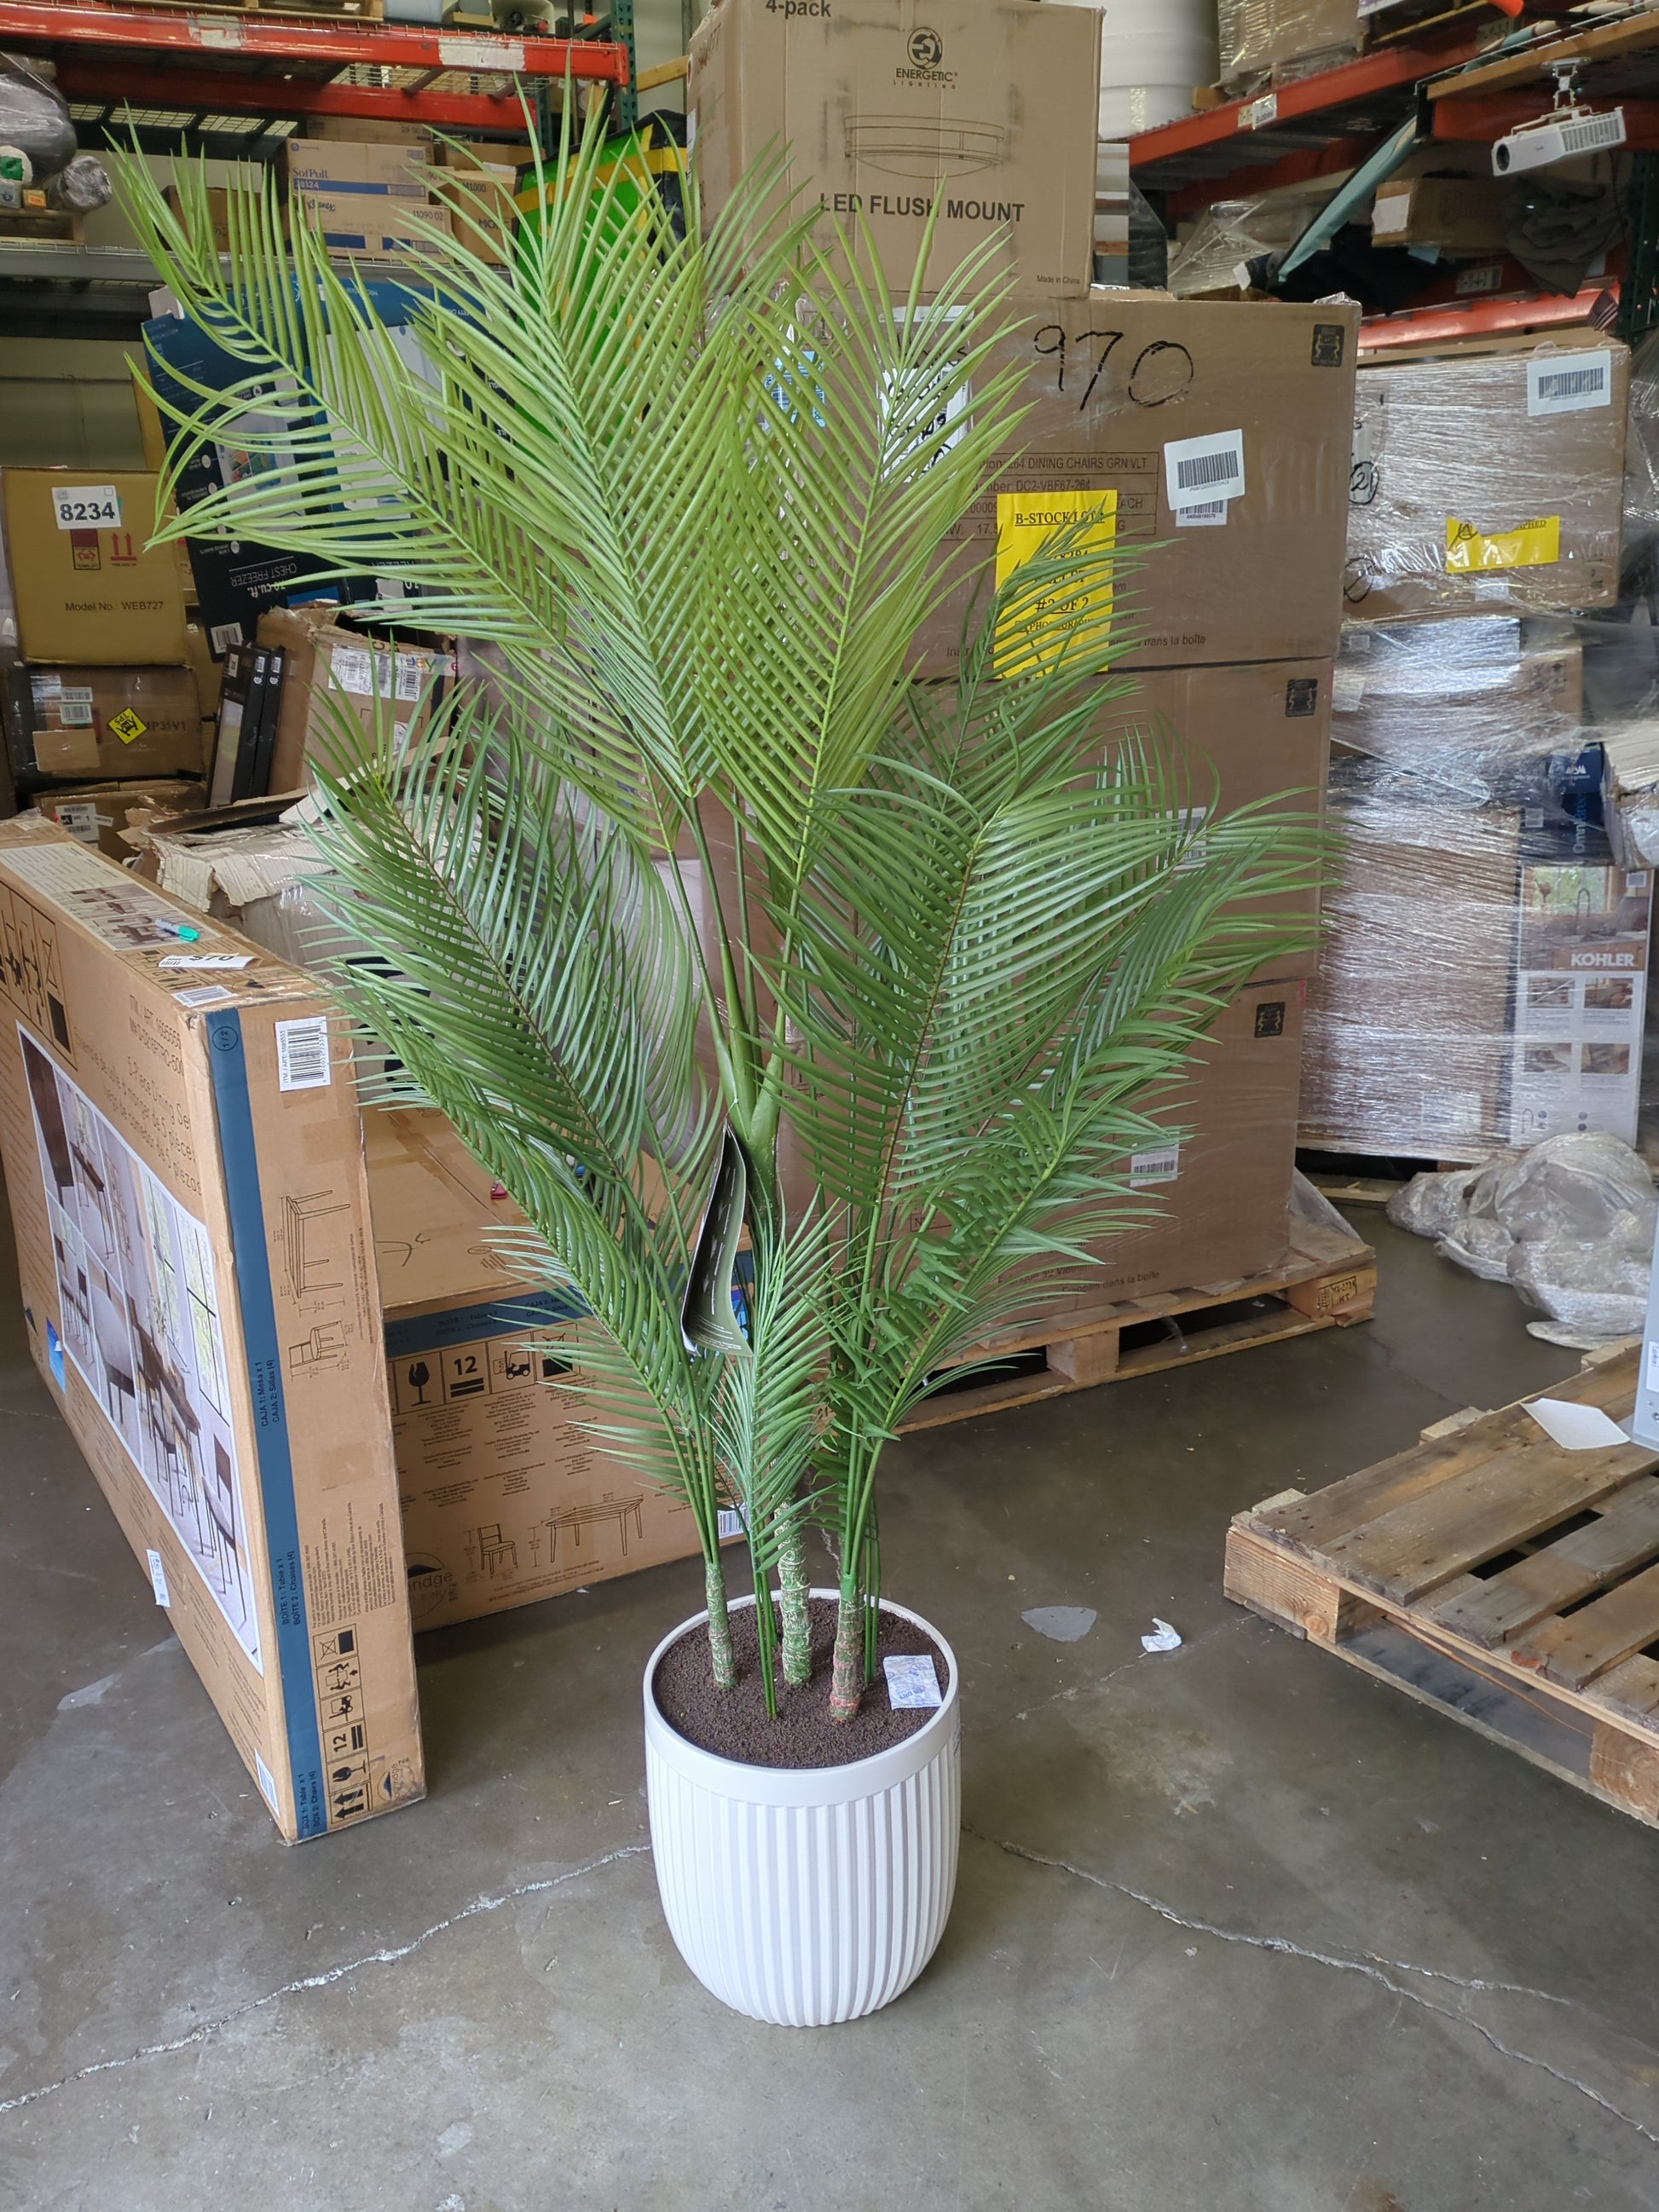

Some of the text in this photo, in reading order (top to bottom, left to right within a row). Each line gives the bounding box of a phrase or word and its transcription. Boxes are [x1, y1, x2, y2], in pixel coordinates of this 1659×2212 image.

[766, 0, 832, 19] 4-pack
[292, 170, 328, 179] SofPull
[819, 193, 1026, 222] LED FLUSH MOUNT
[1037, 274, 1055, 283] Made
[1062, 276, 1081, 286] China
[1034, 325, 1194, 411] 970
[1028, 457, 1064, 469] DINING
[1067, 457, 1103, 469] CHAIRS
[1107, 457, 1128, 469] GRN
[1130, 457, 1147, 469] VLT
[60, 502, 115, 522] 8234
[230, 562, 298, 586] CHEST FREEZER
[65, 602, 96, 611] Model
[121, 601, 164, 611] WEB727
[1171, 636, 1179, 645] la
[1570, 952, 1635, 967] KOHLER
[266, 1360, 275, 1370] (4)
[454, 1356, 477, 1376] 12
[257, 1373, 265, 1396] Mesa
[269, 1371, 277, 1392] Sillas
[259, 1405, 269, 1427] CAJA
[271, 1401, 280, 1423] CAJA
[332, 1733, 348, 1753] 12
[298, 1787, 308, 1806] Table
[308, 1781, 318, 1804] Chairs
